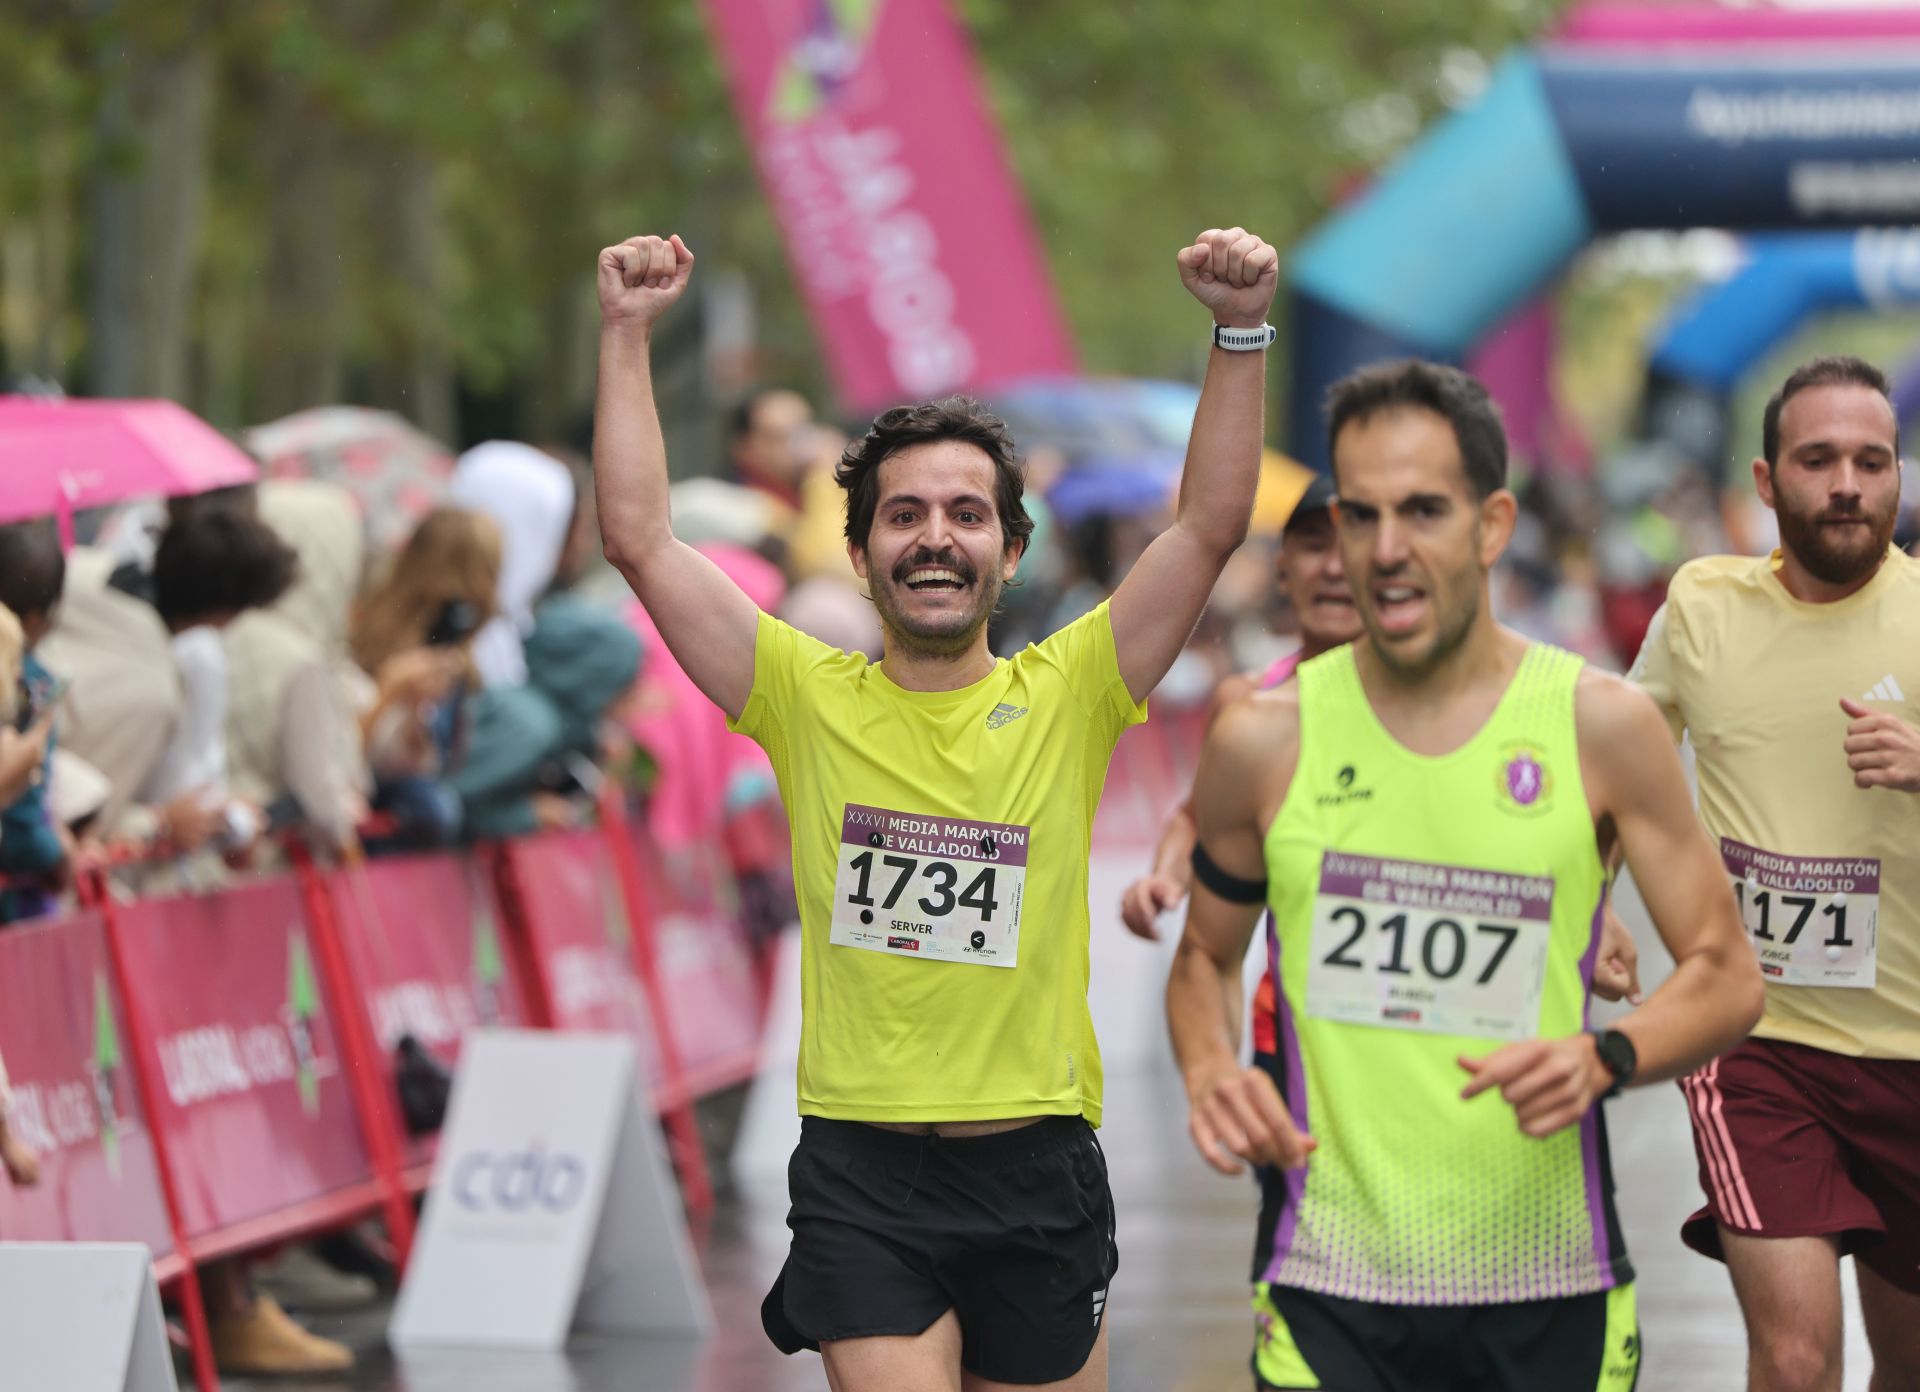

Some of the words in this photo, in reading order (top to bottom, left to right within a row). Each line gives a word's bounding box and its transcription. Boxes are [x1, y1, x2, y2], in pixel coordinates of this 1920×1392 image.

[986, 707, 1029, 730] adidas
[847, 810, 885, 828] XXXVI
[889, 818, 939, 836] MEDIA
[944, 824, 1025, 846] MARATÓN
[1380, 860, 1448, 886] MEDIA
[1753, 852, 1796, 874] MEDIA
[1800, 858, 1878, 877] MARATÓN
[848, 851, 998, 922] 1734
[1761, 872, 1855, 892] VALLADOLID
[1362, 880, 1391, 901] DE
[1394, 885, 1523, 918] VALLADOLID
[890, 919, 933, 935] SERVER
[1323, 905, 1520, 986] 2107
